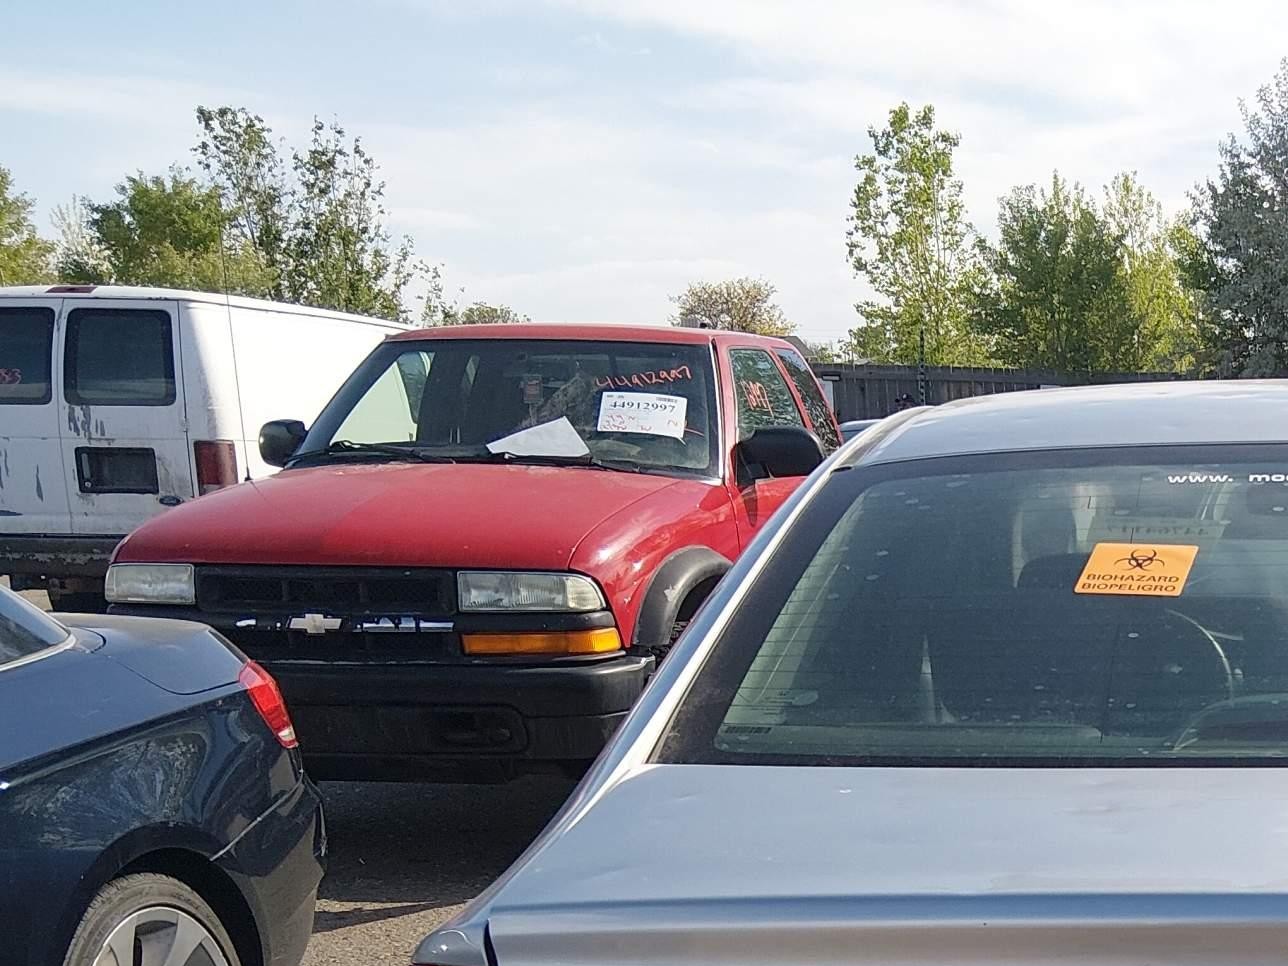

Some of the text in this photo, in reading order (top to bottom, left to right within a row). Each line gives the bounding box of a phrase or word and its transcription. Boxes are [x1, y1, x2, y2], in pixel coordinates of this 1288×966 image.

[609, 400, 676, 413] 44912997
[1168, 473, 1234, 484] www.
[1086, 573, 1180, 584] BIOHAZARD
[1081, 582, 1176, 593] BIOPELIGRO
